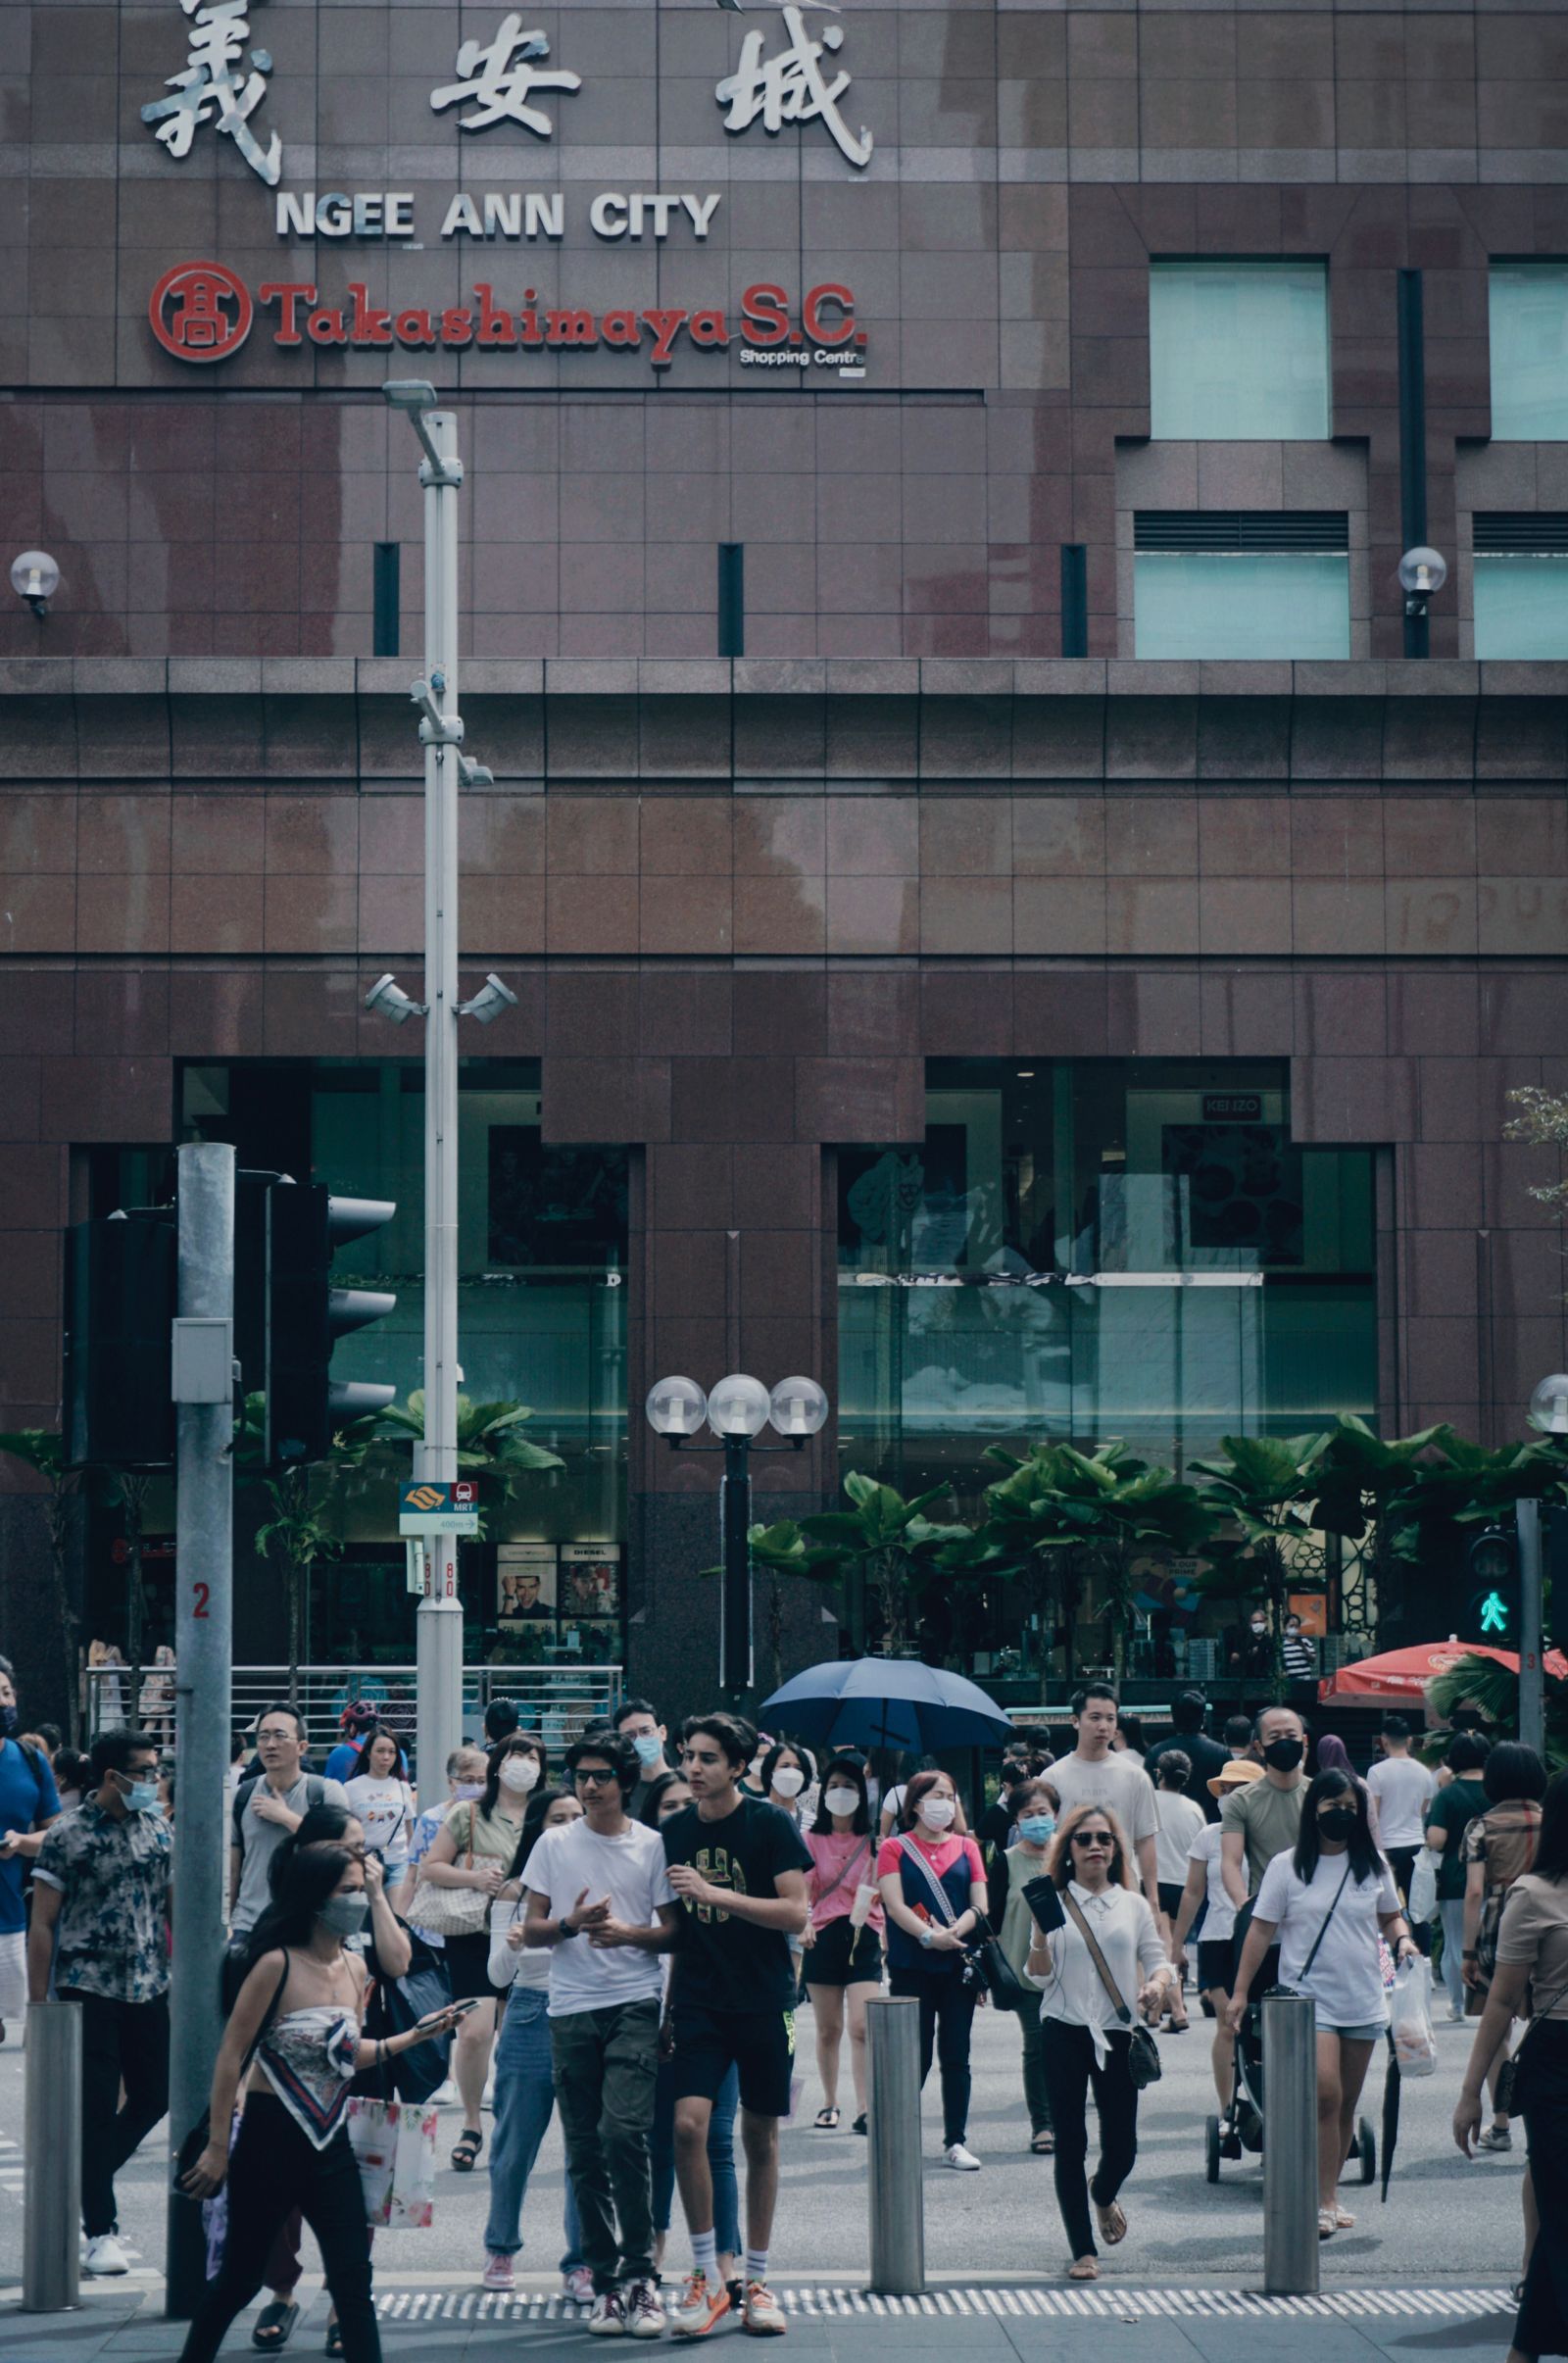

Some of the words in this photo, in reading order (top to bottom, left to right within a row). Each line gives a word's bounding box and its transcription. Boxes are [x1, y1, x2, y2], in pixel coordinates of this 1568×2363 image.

[276, 192, 415, 235] NGEE
[440, 193, 564, 235] ANN
[590, 193, 721, 236] CITY
[259, 282, 729, 365] Takashimaya
[740, 349, 809, 365] Shopping
[813, 349, 864, 365] Centre
[1206, 1099, 1258, 1112] KENZO
[454, 1502, 473, 1512] MRT
[193, 1582, 210, 1619] 2
[1528, 1652, 1536, 1670] 3
